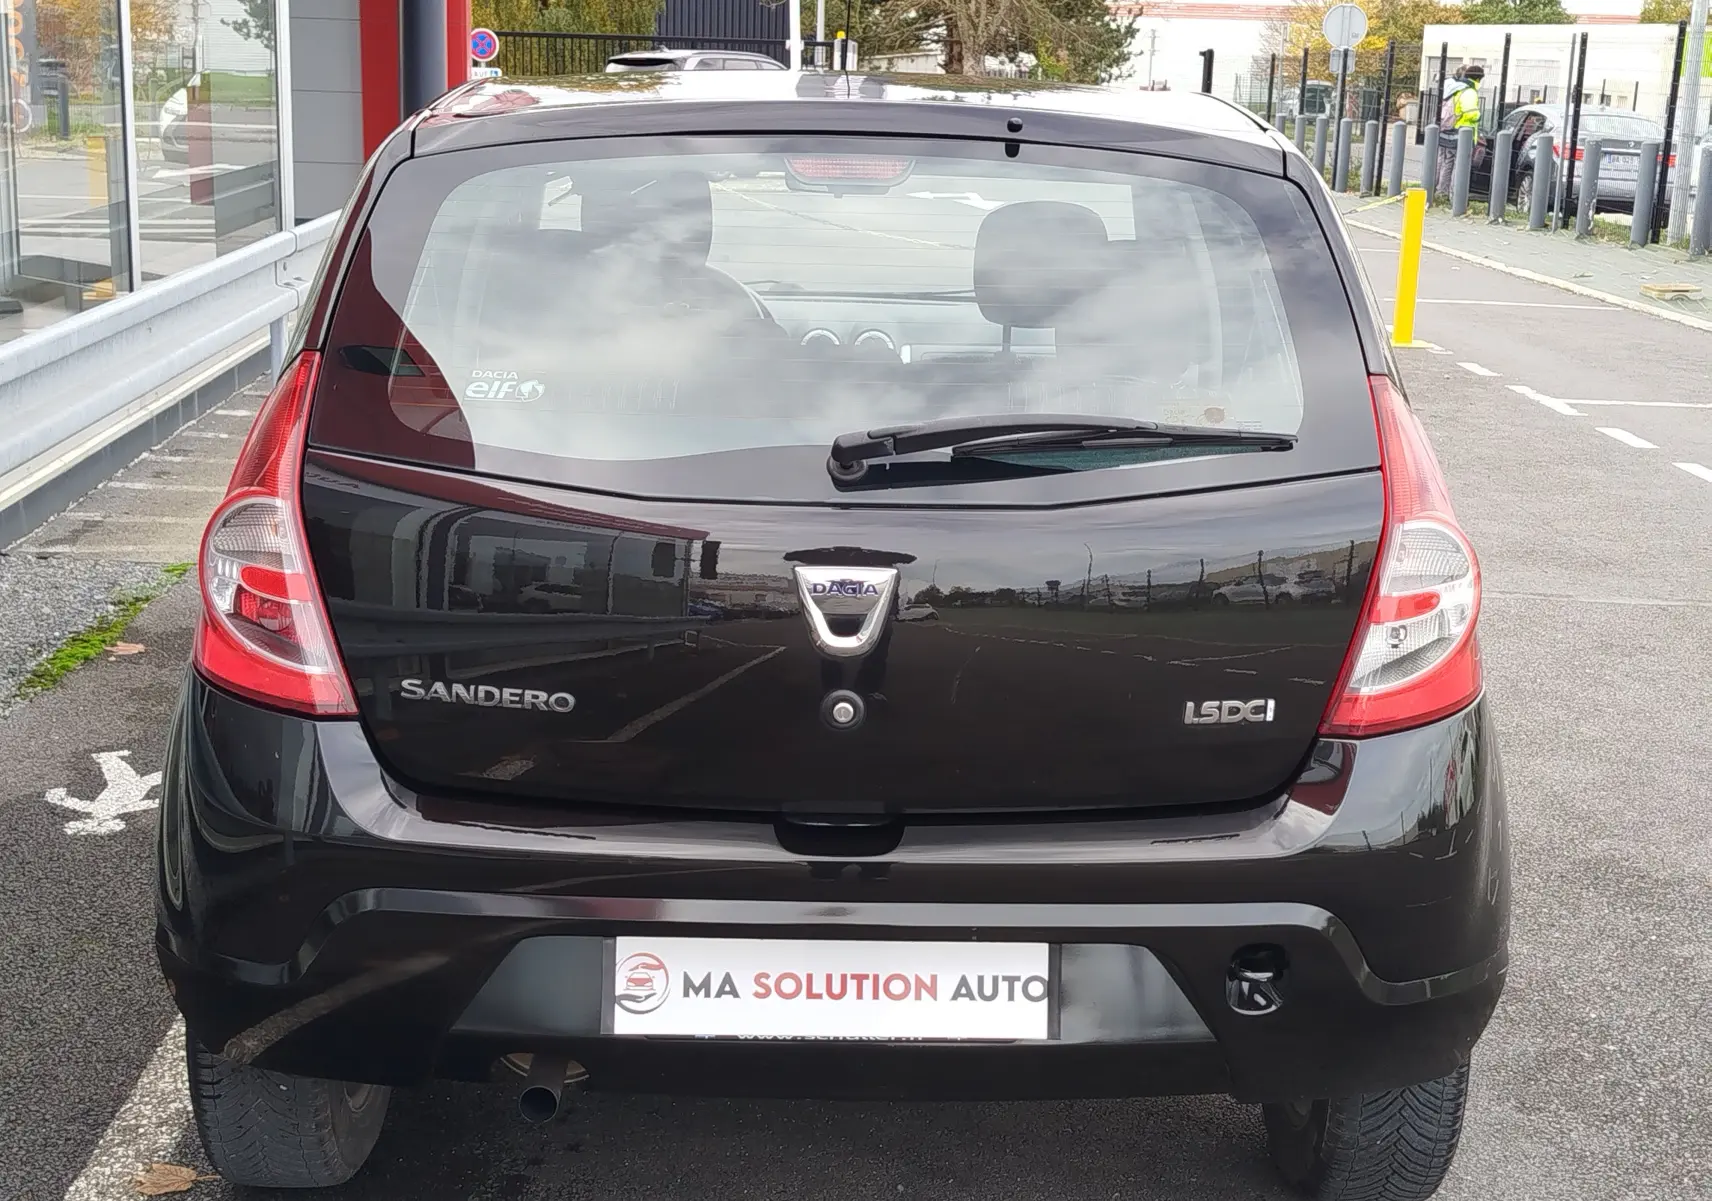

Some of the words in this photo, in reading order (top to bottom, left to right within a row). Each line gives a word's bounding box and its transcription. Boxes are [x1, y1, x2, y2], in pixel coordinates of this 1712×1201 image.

[472, 370, 519, 379] DACIA
[465, 380, 517, 398] elf
[812, 582, 879, 596] DACIA
[400, 678, 576, 712] SANDERO
[683, 971, 741, 998] MA
[752, 972, 938, 1001] SOLUTION
[949, 974, 1049, 1002] AUTO
